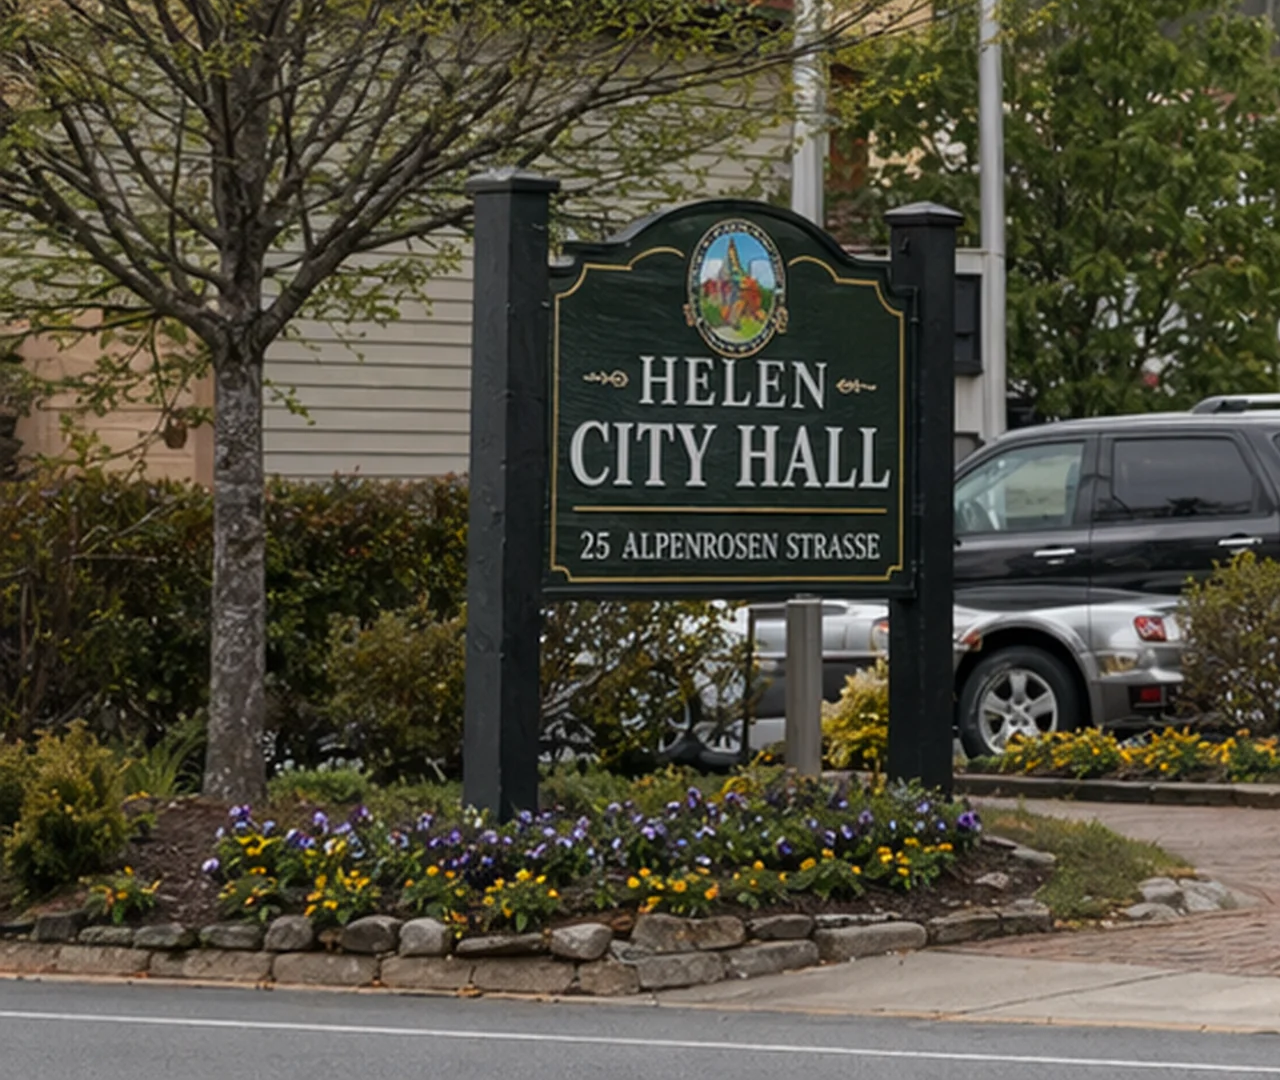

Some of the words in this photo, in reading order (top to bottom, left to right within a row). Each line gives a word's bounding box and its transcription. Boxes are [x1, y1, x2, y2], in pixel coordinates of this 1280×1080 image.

[639, 355, 828, 409] HELEN
[569, 420, 718, 487] CITY
[735, 424, 891, 489] HALL
[580, 531, 611, 560] 25
[622, 531, 778, 560] ALPENROSEN
[786, 532, 880, 561] STRASSE
